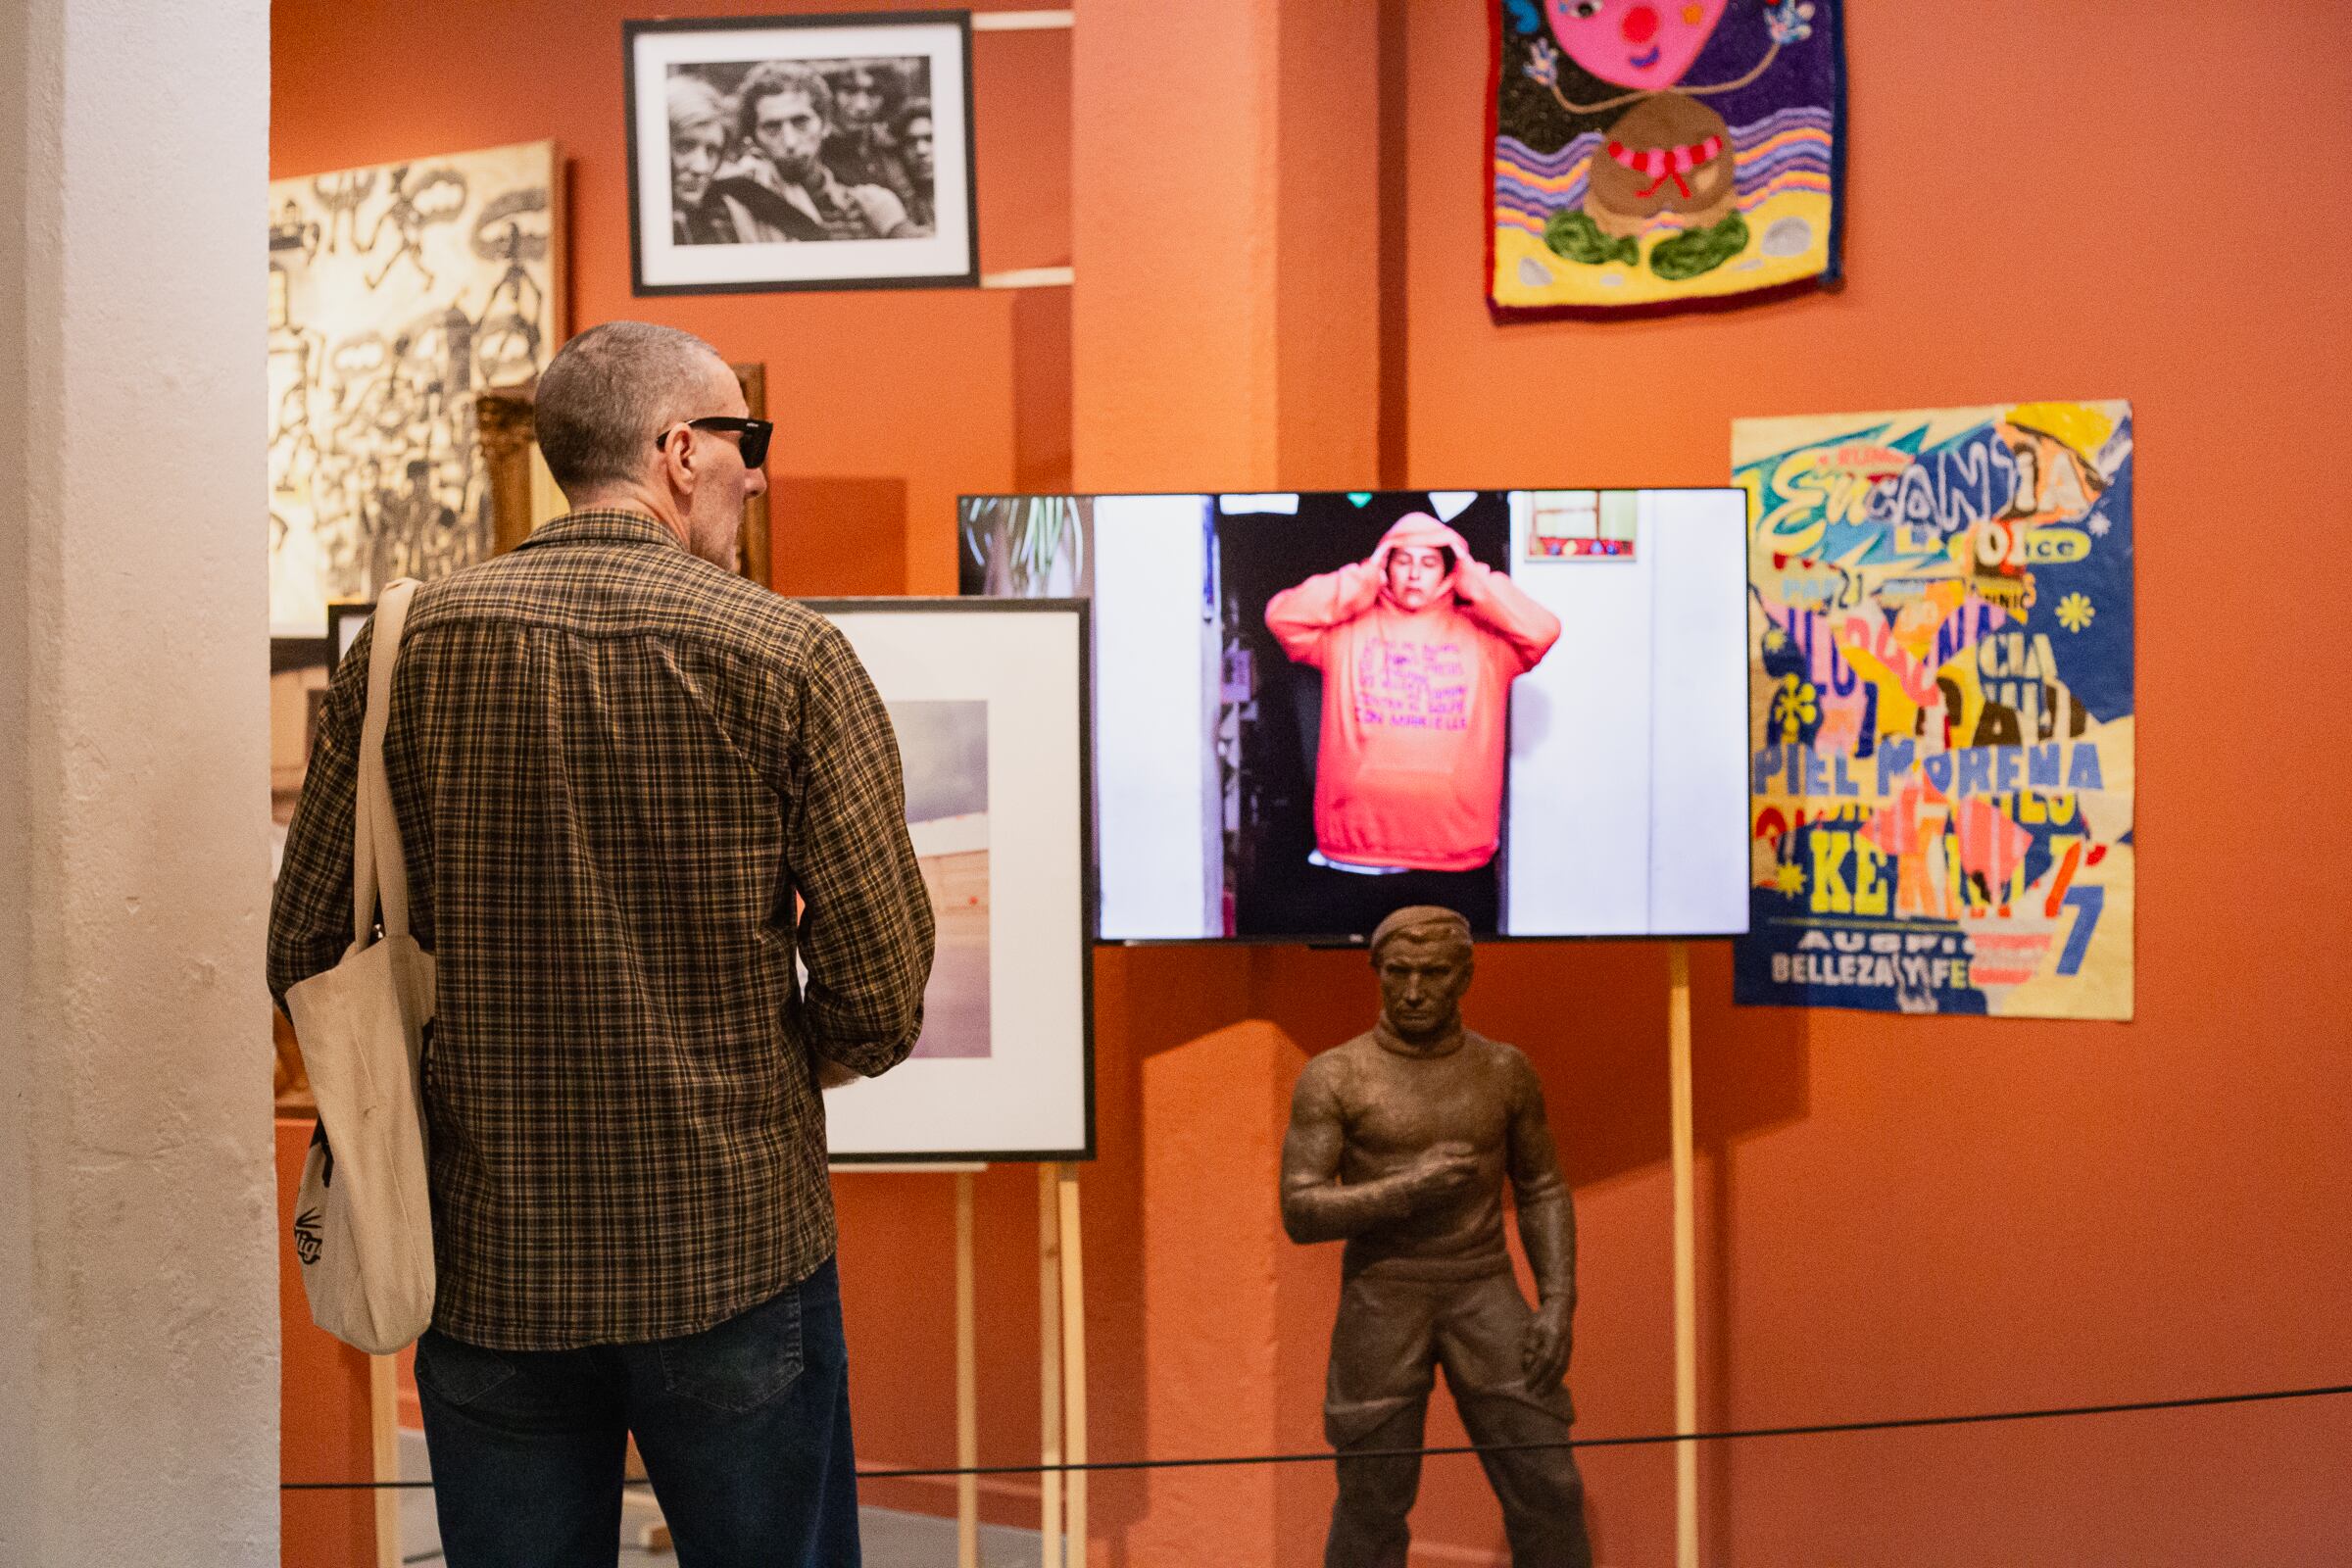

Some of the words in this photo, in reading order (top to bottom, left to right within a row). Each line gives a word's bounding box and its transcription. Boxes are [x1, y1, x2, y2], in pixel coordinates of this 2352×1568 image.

[1754, 742, 1859, 797] PIEL
[1877, 738, 2104, 799] MORENA
[1771, 953, 1895, 988] BELLEZA
